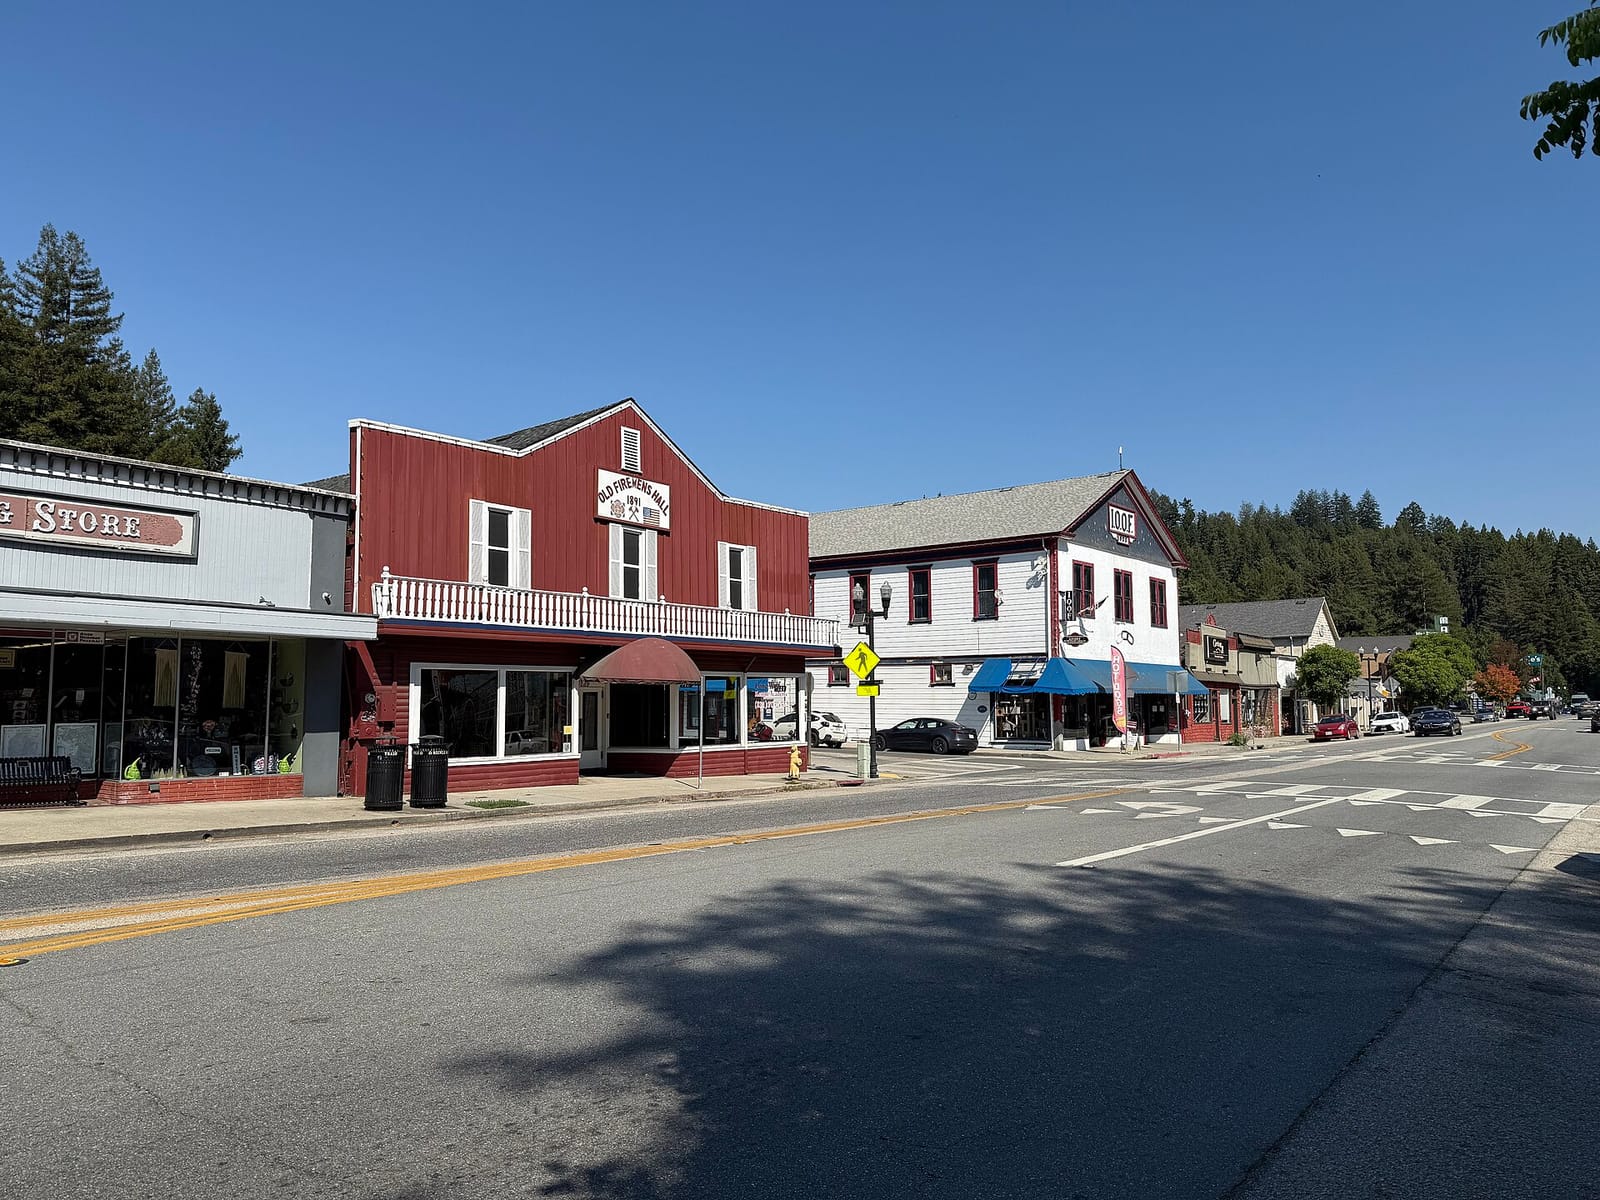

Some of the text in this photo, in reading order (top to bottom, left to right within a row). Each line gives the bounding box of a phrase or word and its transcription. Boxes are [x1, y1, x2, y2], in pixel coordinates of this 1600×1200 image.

[598, 477, 669, 517] OLD FIREMENS HALL
[626, 495, 641, 507] 1891
[32, 501, 141, 539] STORE
[1112, 655, 1121, 682] HOT
